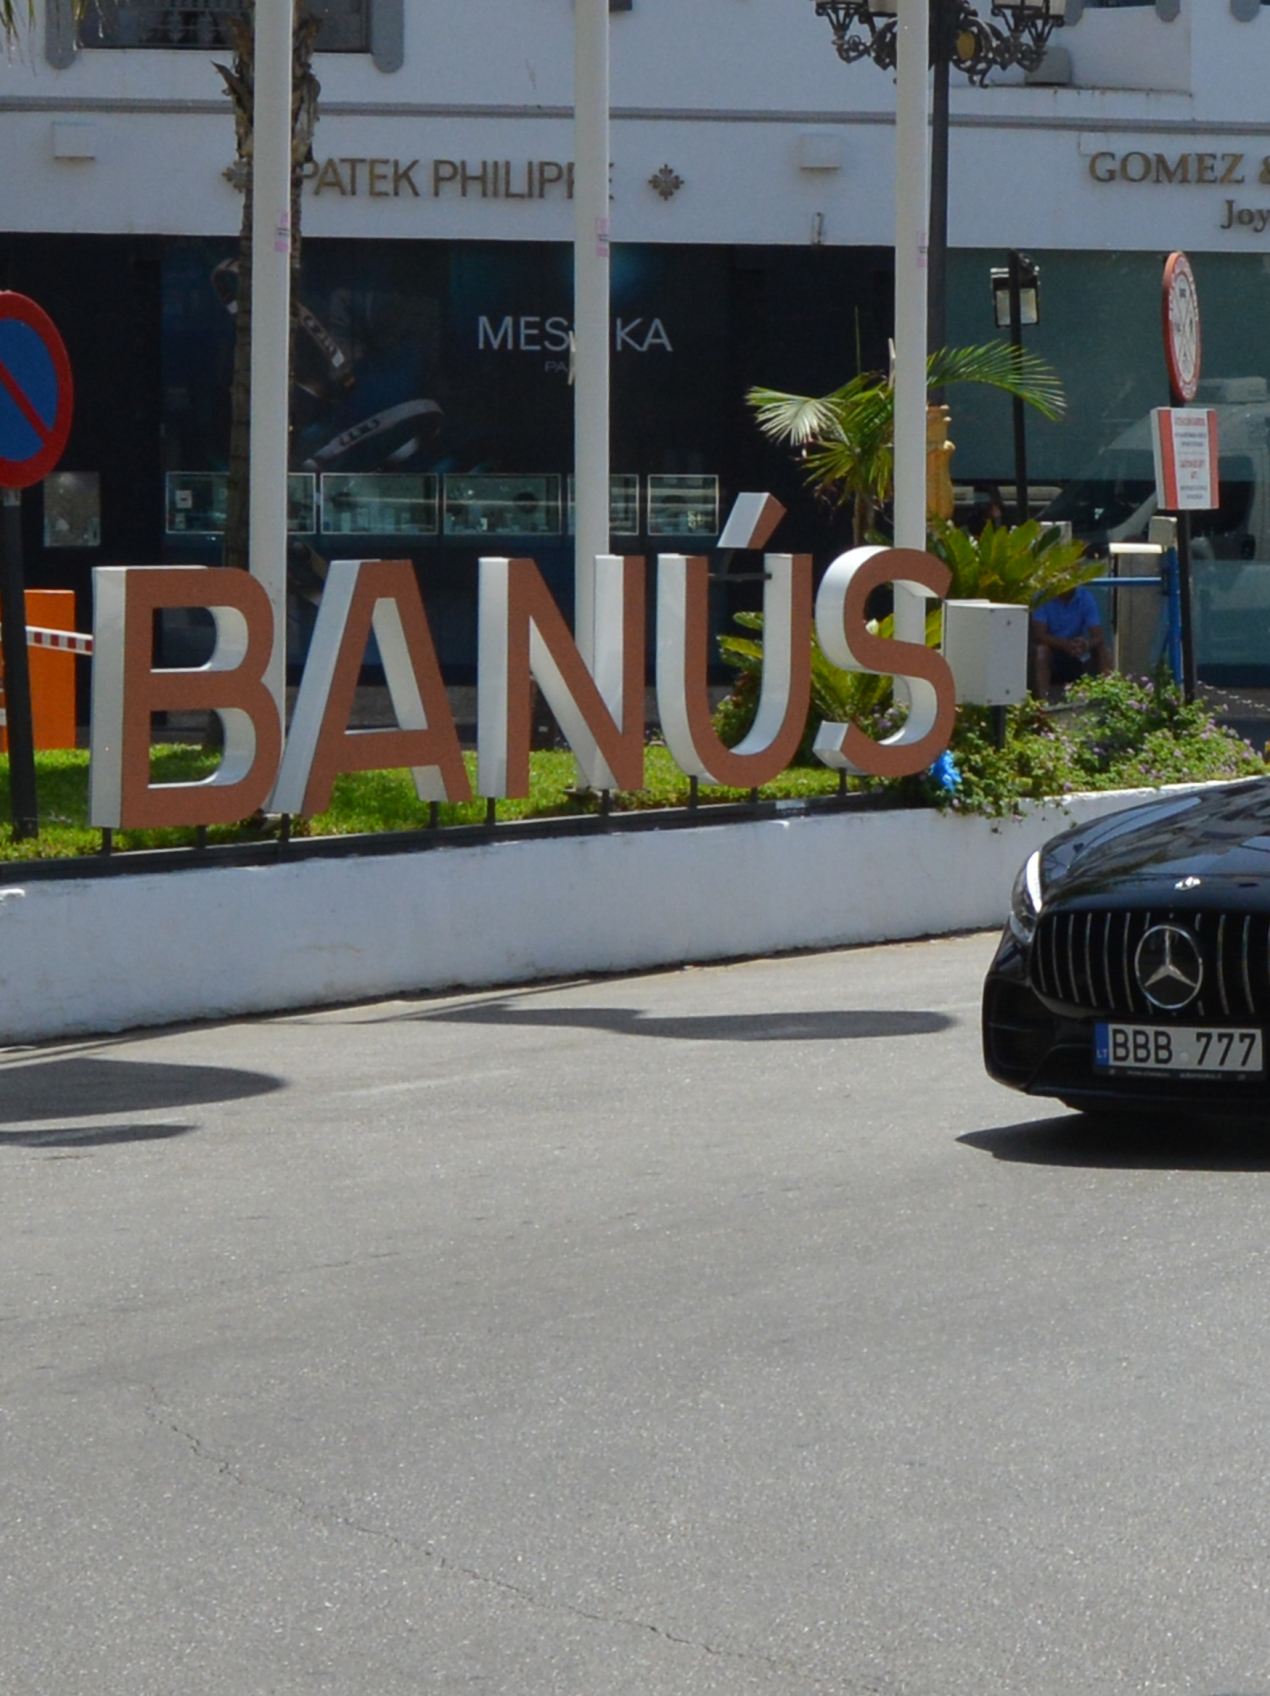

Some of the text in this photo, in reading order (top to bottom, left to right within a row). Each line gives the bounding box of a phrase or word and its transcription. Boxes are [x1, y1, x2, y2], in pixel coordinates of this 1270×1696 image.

[1089, 152, 1245, 184] GOMEZ
[478, 315, 674, 352] MESKA
[91, 492, 956, 828] BANÚS
[1095, 1048, 1109, 1059] LT
[1112, 1028, 1256, 1067] BBB 777
